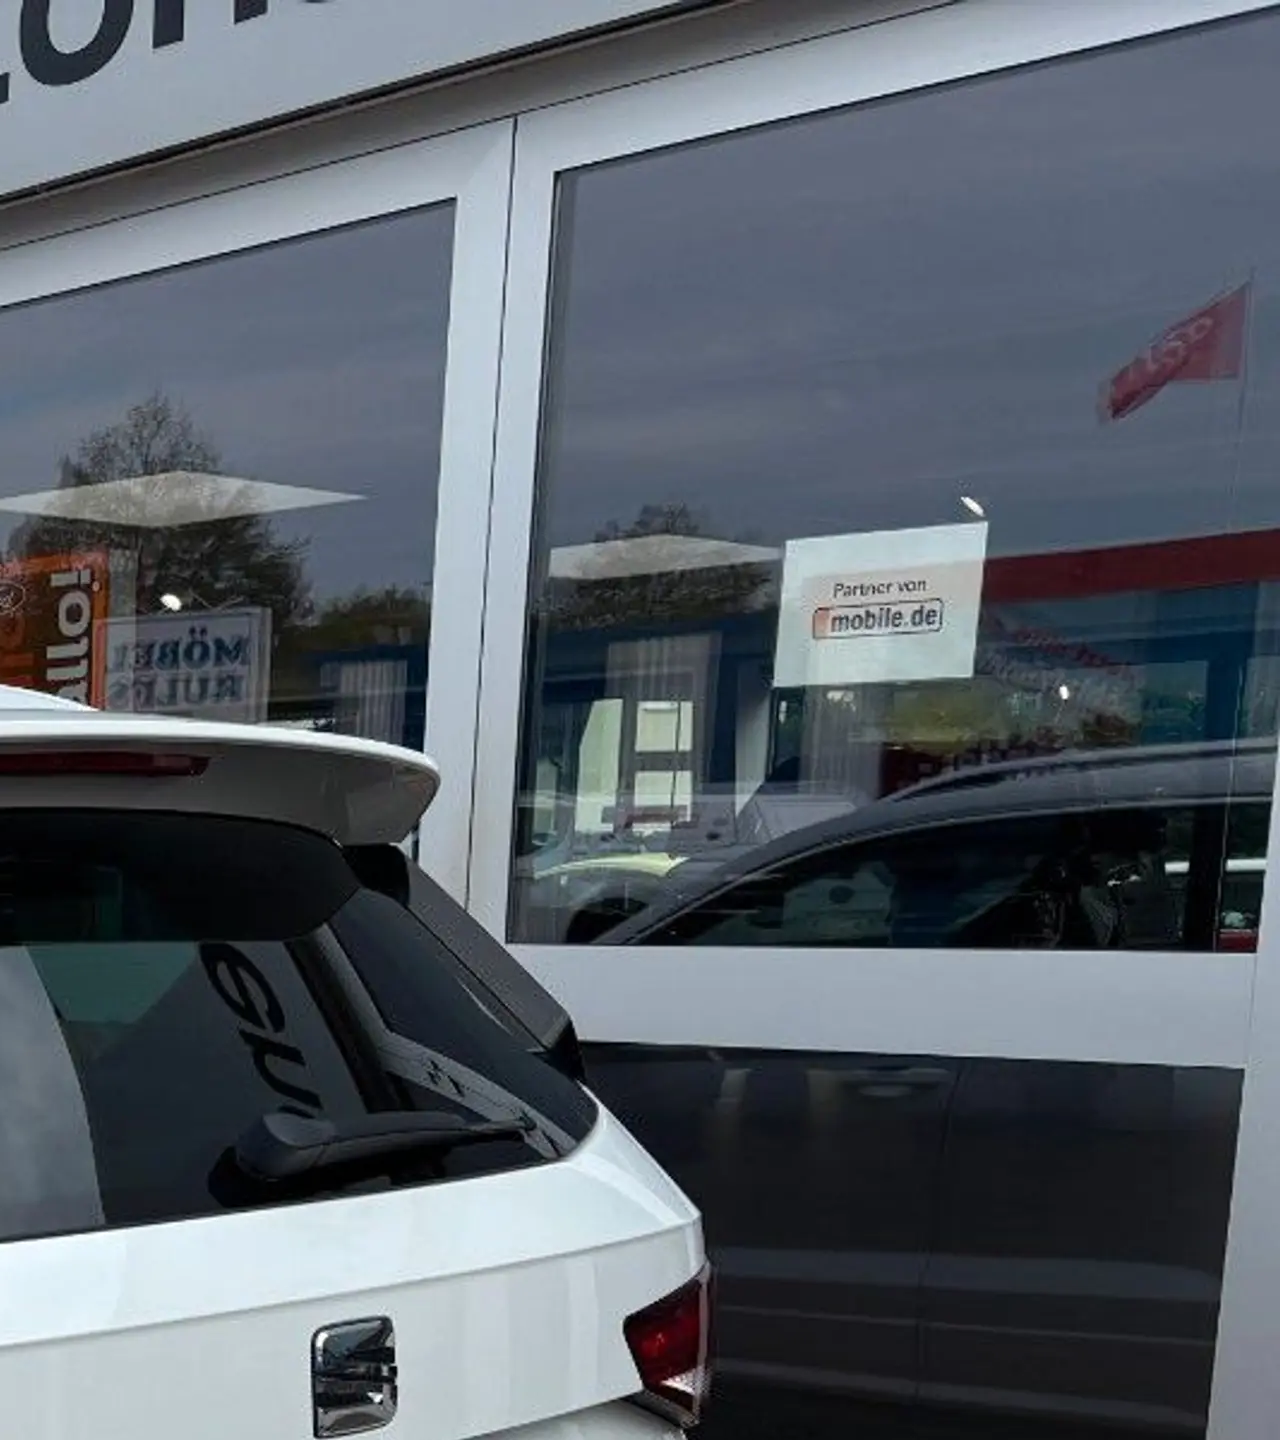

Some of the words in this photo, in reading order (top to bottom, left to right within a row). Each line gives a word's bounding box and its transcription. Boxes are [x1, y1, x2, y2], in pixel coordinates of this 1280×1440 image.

[833, 581, 894, 598] Partner
[897, 579, 927, 593] von
[830, 604, 938, 632] mobile.de
